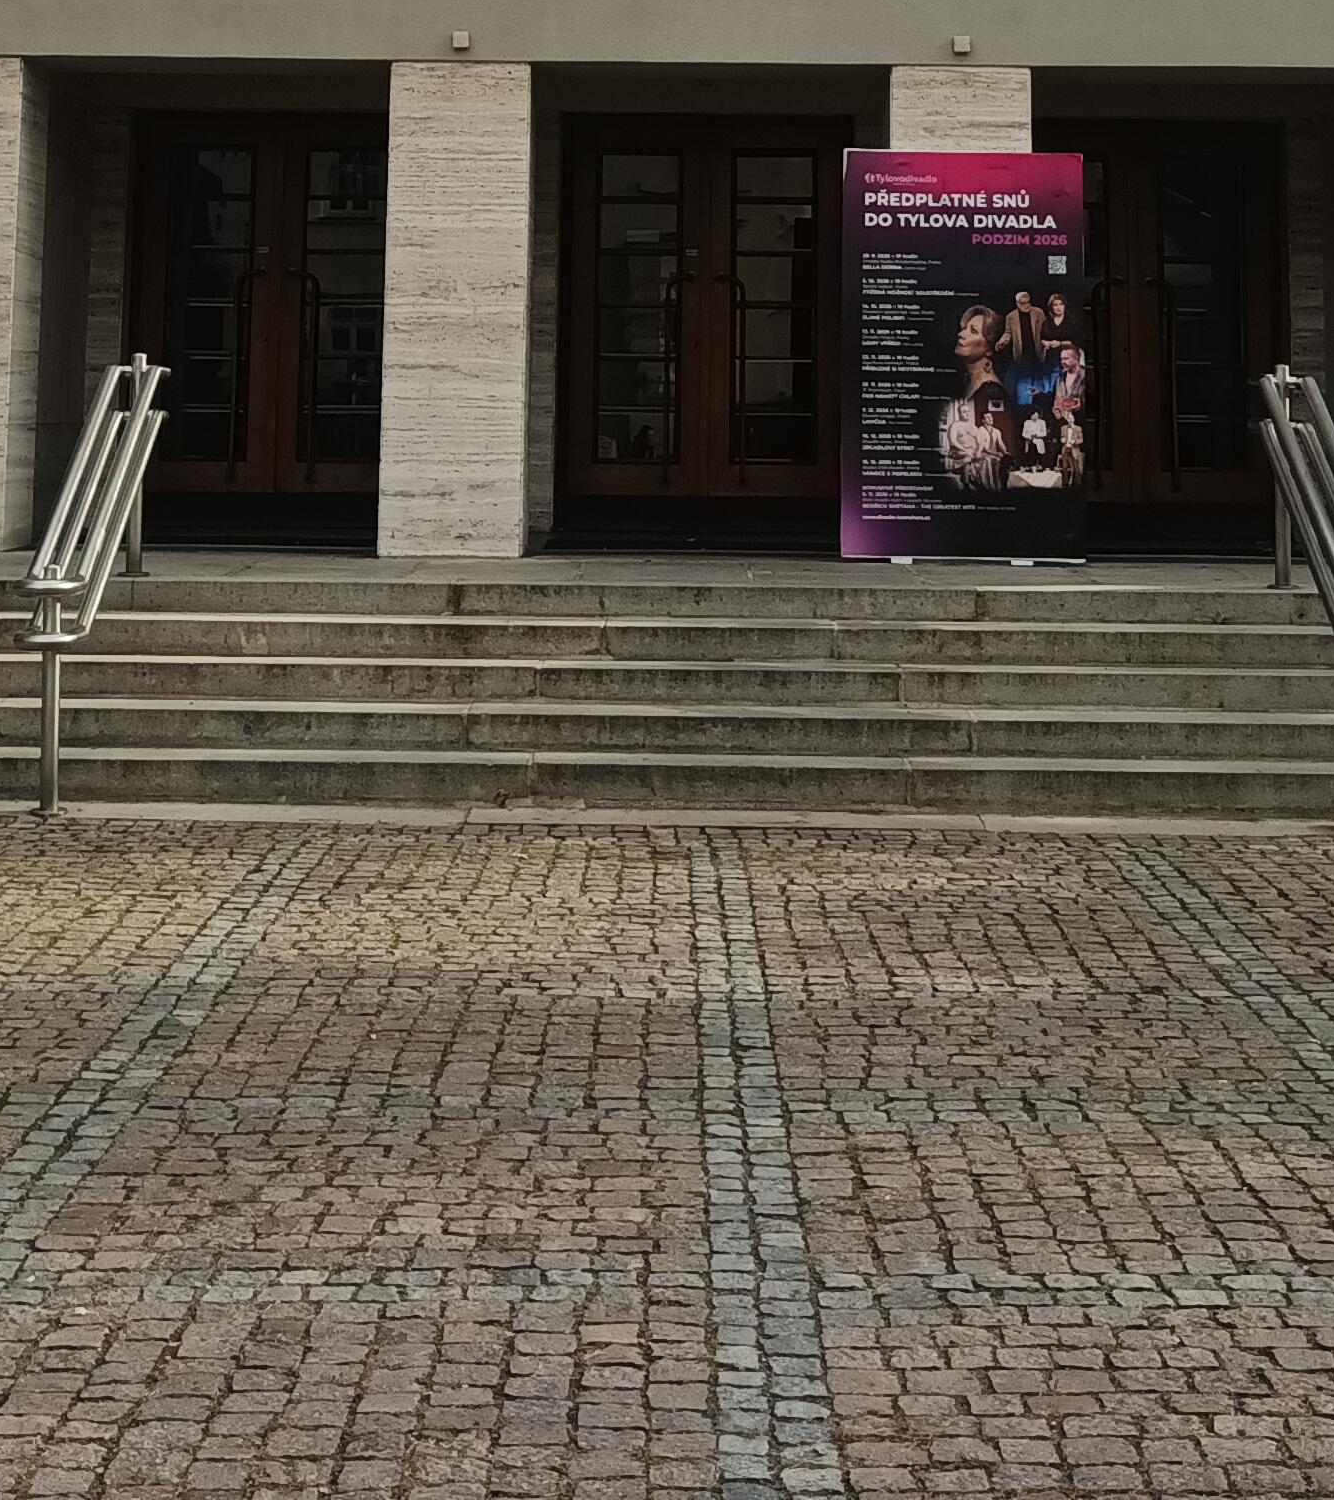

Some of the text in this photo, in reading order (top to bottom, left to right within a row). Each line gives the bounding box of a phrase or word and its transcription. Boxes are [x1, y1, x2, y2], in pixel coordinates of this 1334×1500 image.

[864, 189, 1030, 208] PŘEDPLATNÉ SNŮ
[864, 212, 1057, 229] DO TYLOVA DIVADLA
[971, 233, 1030, 246] PODZIM
